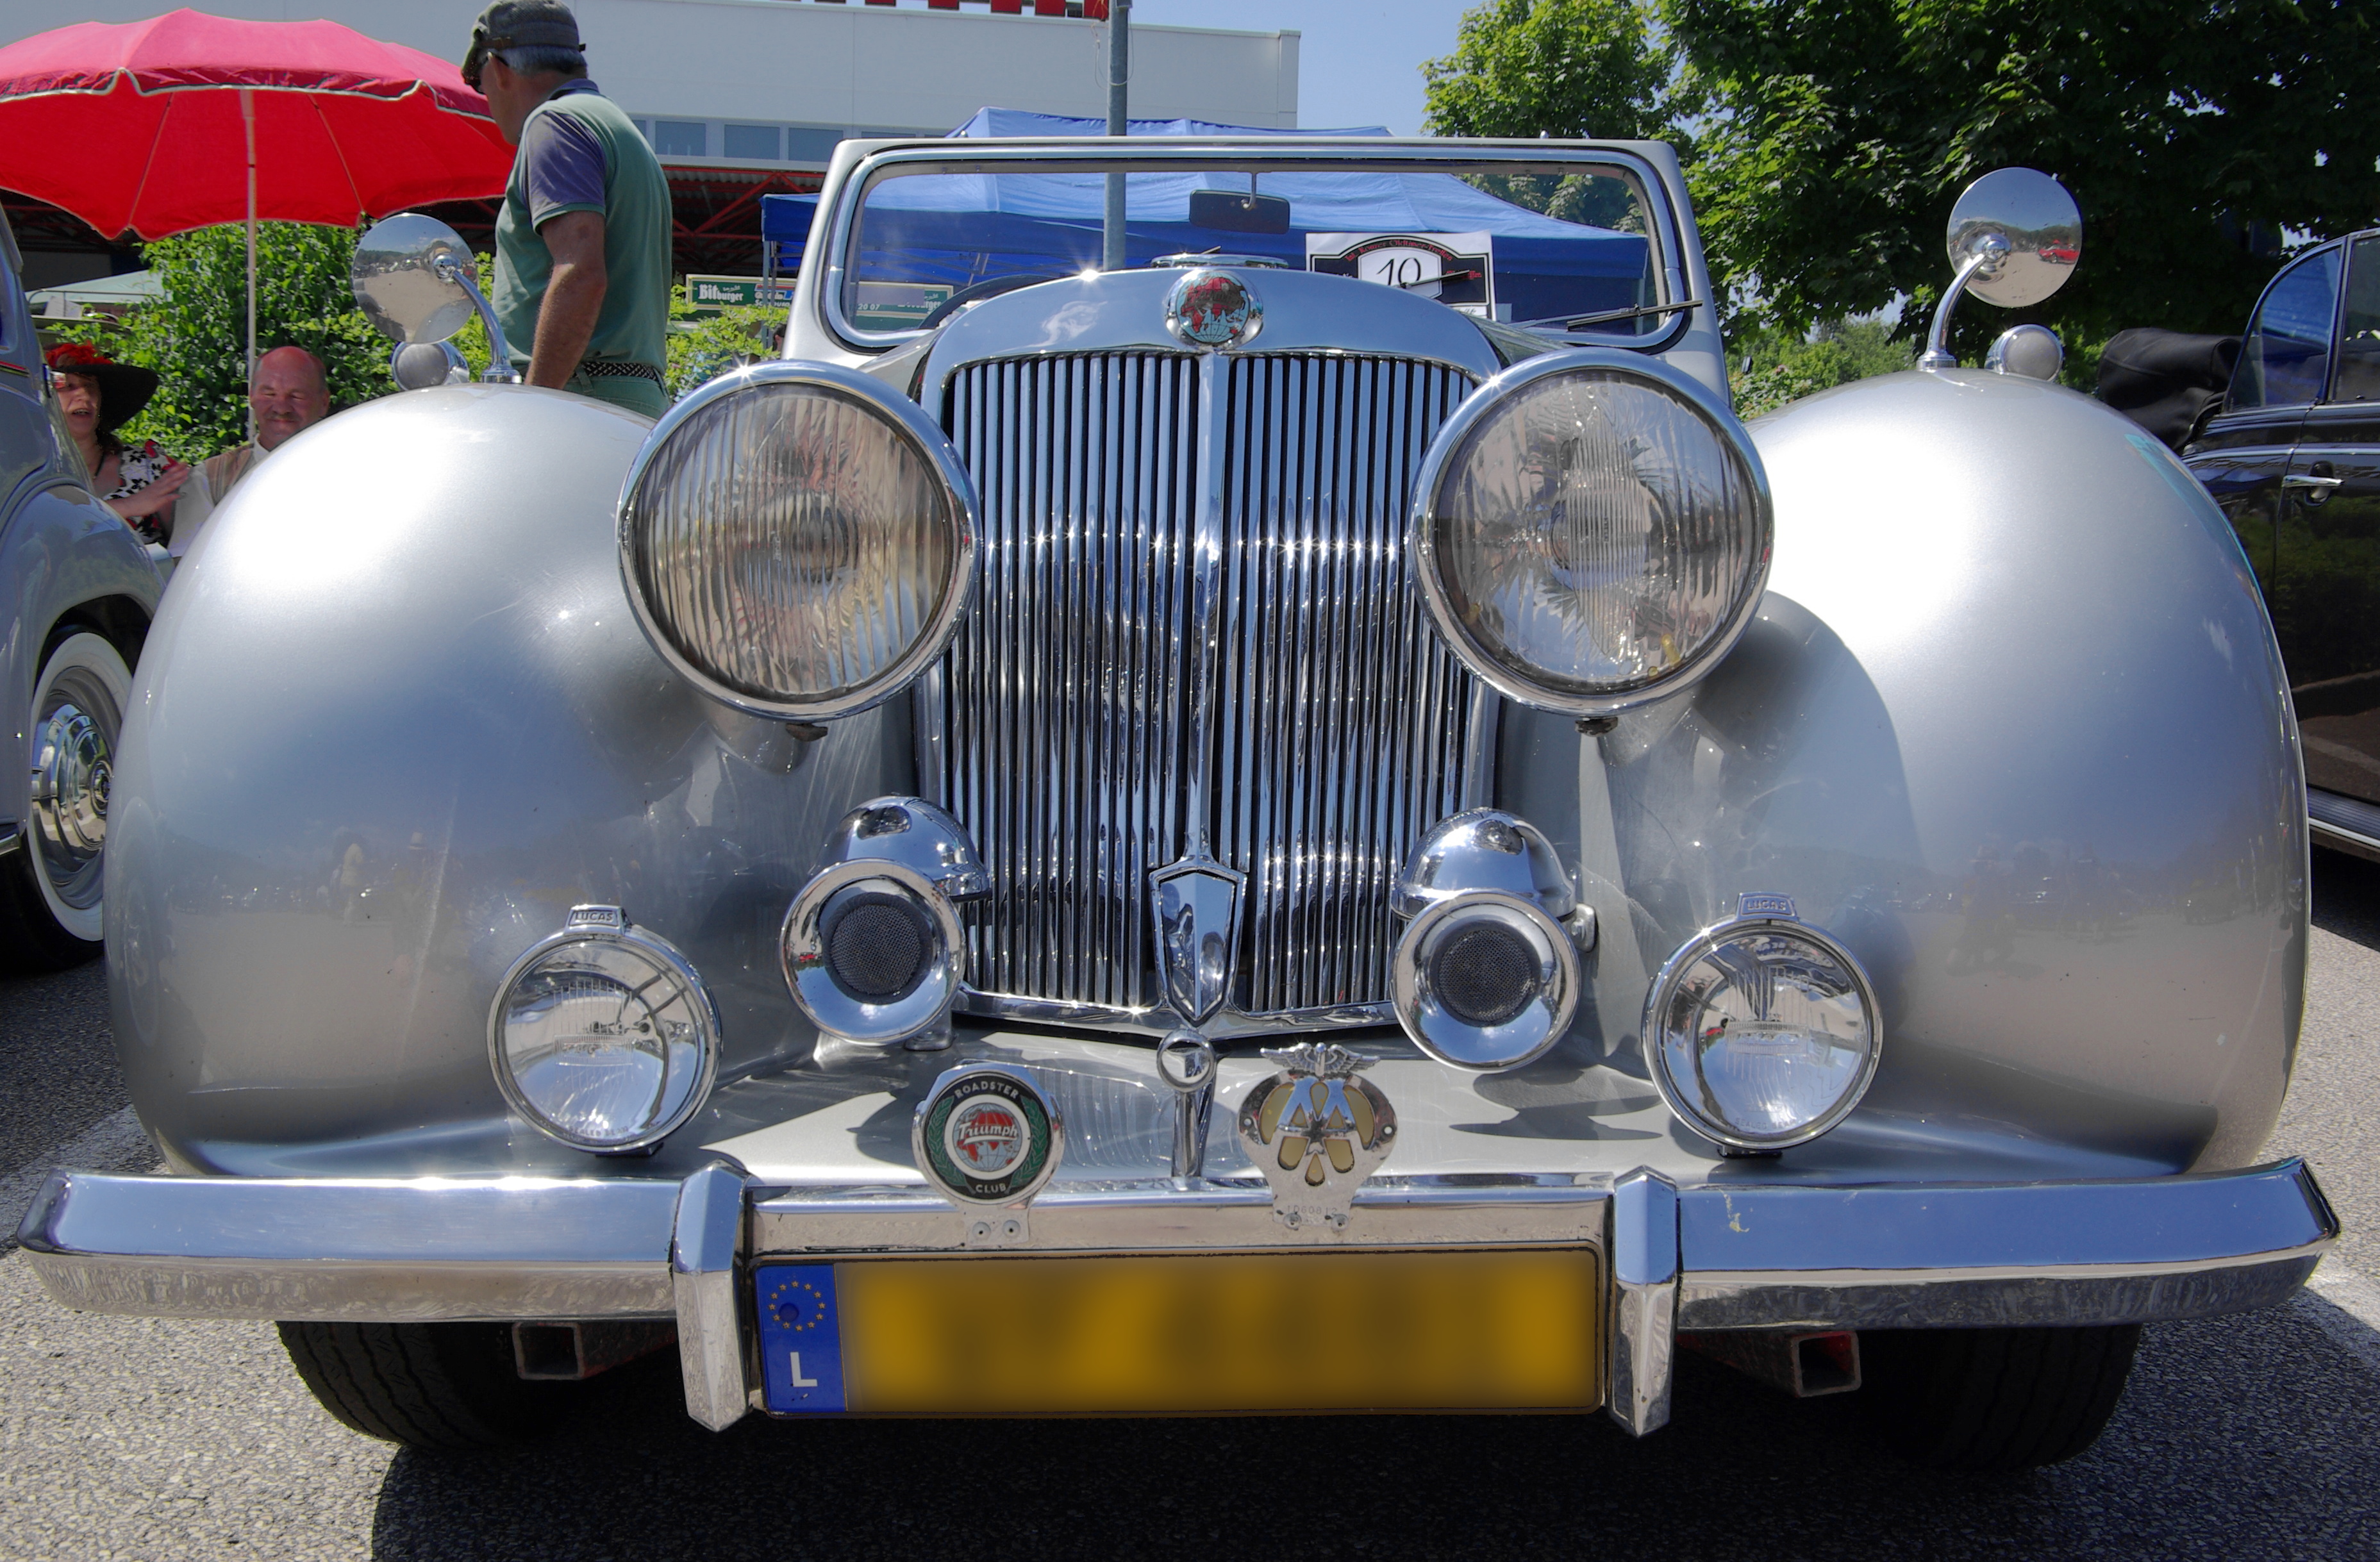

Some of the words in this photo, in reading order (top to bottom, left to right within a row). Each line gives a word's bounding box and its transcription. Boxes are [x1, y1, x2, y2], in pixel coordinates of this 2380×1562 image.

[1376, 258, 1422, 287] 10
[698, 284, 744, 303] Bitburger
[1746, 899, 1786, 911] LUCAS
[574, 911, 613, 922] LUCAS
[954, 1081, 1019, 1099] ROADSTER
[959, 1120, 1018, 1142] Triumph
[975, 1183, 1007, 1194] CLUB
[790, 1351, 819, 1388] L
